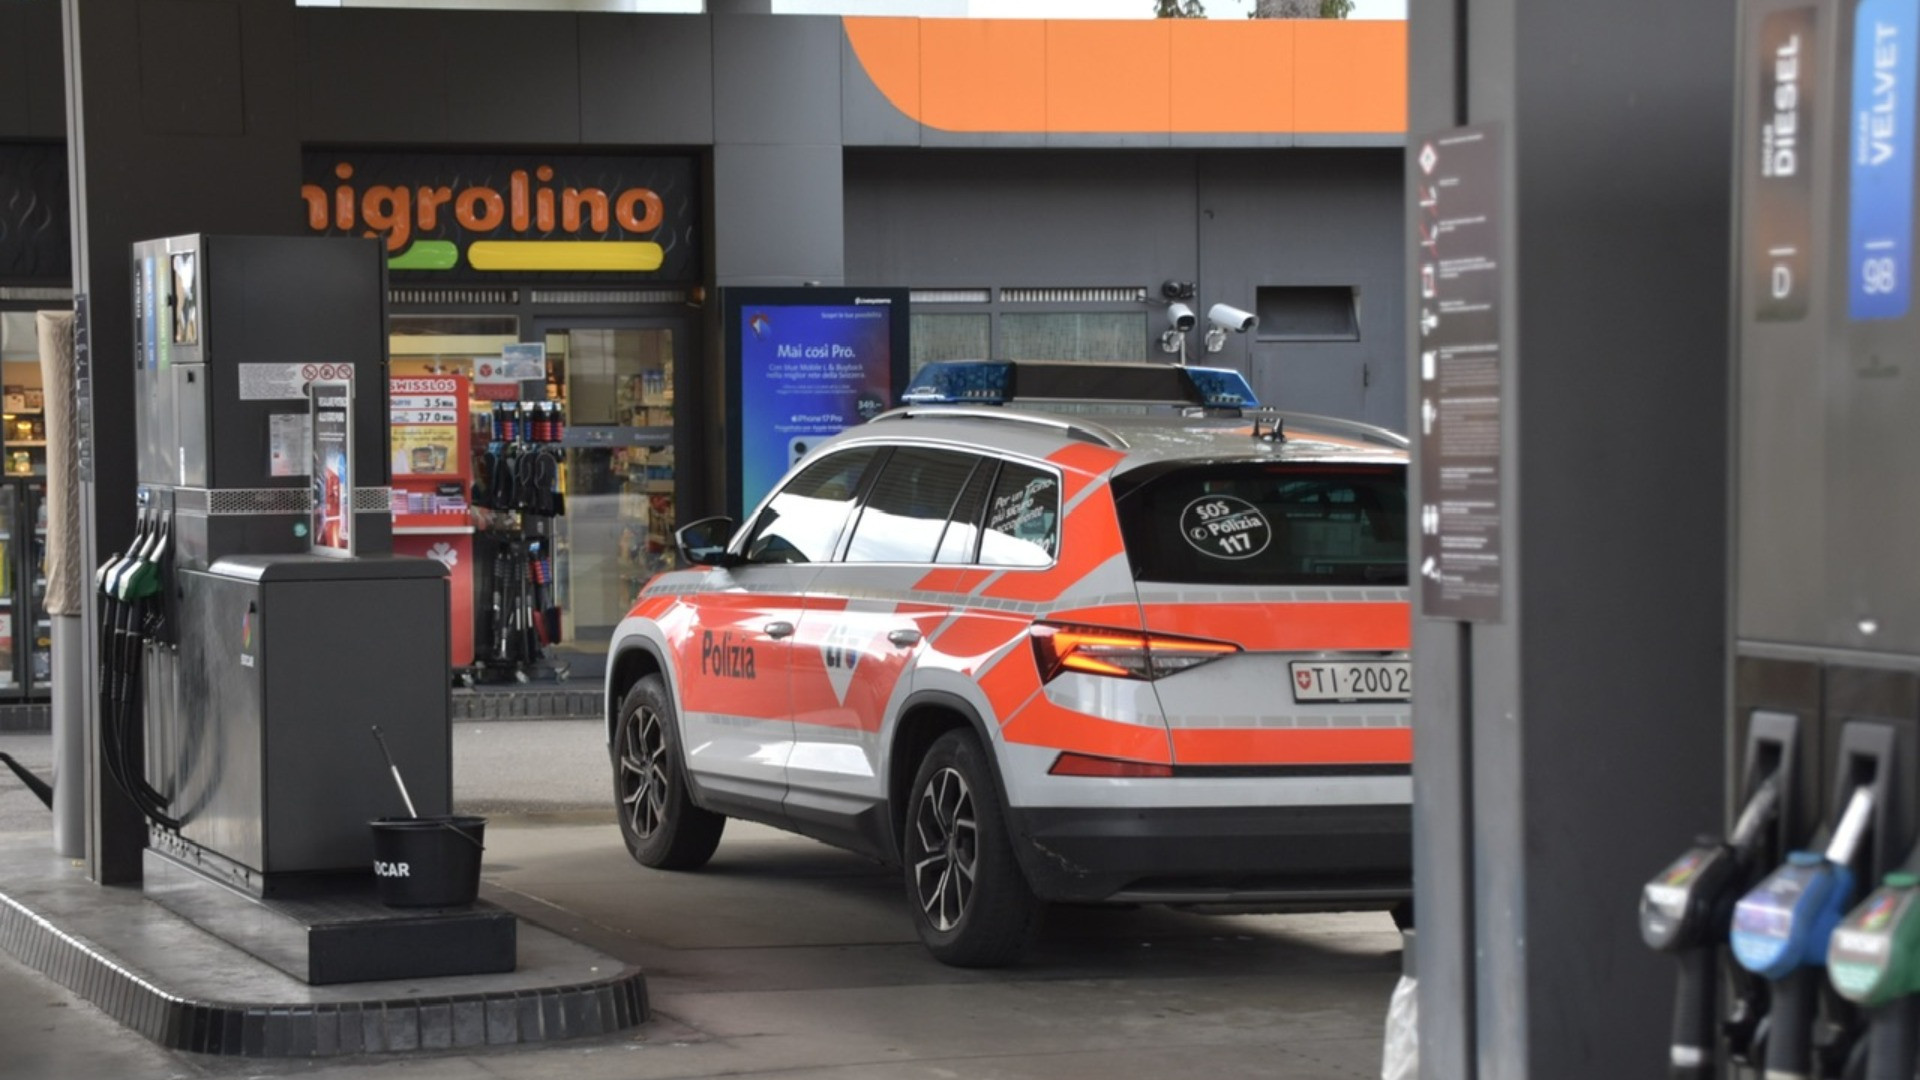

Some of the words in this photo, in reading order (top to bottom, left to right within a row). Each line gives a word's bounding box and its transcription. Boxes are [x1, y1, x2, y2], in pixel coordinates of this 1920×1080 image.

[1773, 33, 1800, 176] DIESEL
[1870, 21, 1898, 165] VELVET
[1771, 264, 1791, 298] D
[1862, 257, 1895, 293] 98
[777, 344, 802, 358] Mai
[805, 344, 829, 358] così
[832, 344, 855, 358] Pro.
[798, 414, 822, 423] iPhone
[823, 414, 830, 422] 17
[831, 414, 842, 422] Pro
[1196, 501, 1230, 520] SOS
[1208, 516, 1263, 537] Polizia
[1219, 533, 1252, 554] 117
[702, 630, 756, 680] Polizia
